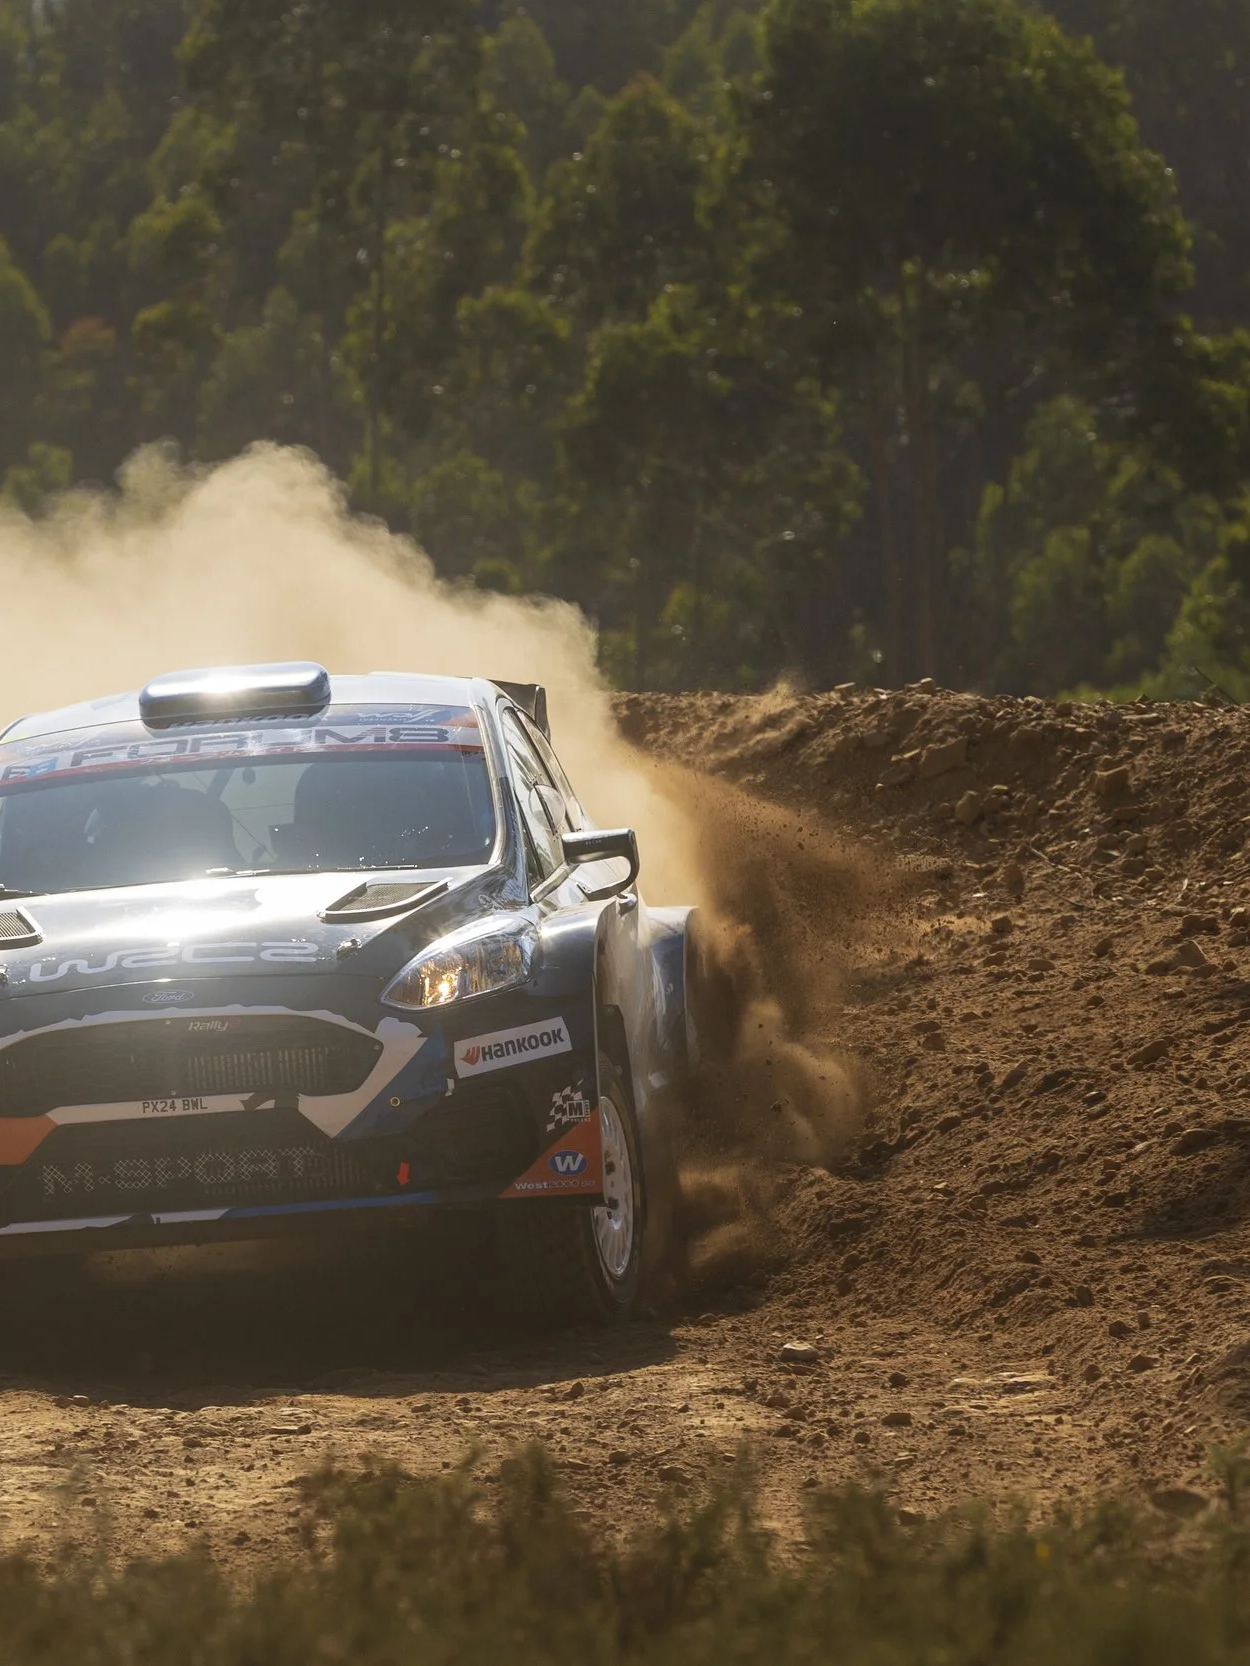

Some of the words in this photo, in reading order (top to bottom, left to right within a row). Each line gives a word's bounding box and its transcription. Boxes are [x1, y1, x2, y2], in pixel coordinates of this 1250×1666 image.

[70, 727, 449, 768] FORUM8
[151, 991, 186, 1002] Ford
[142, 1099, 177, 1113] PX24
[182, 1098, 208, 1111] BWL
